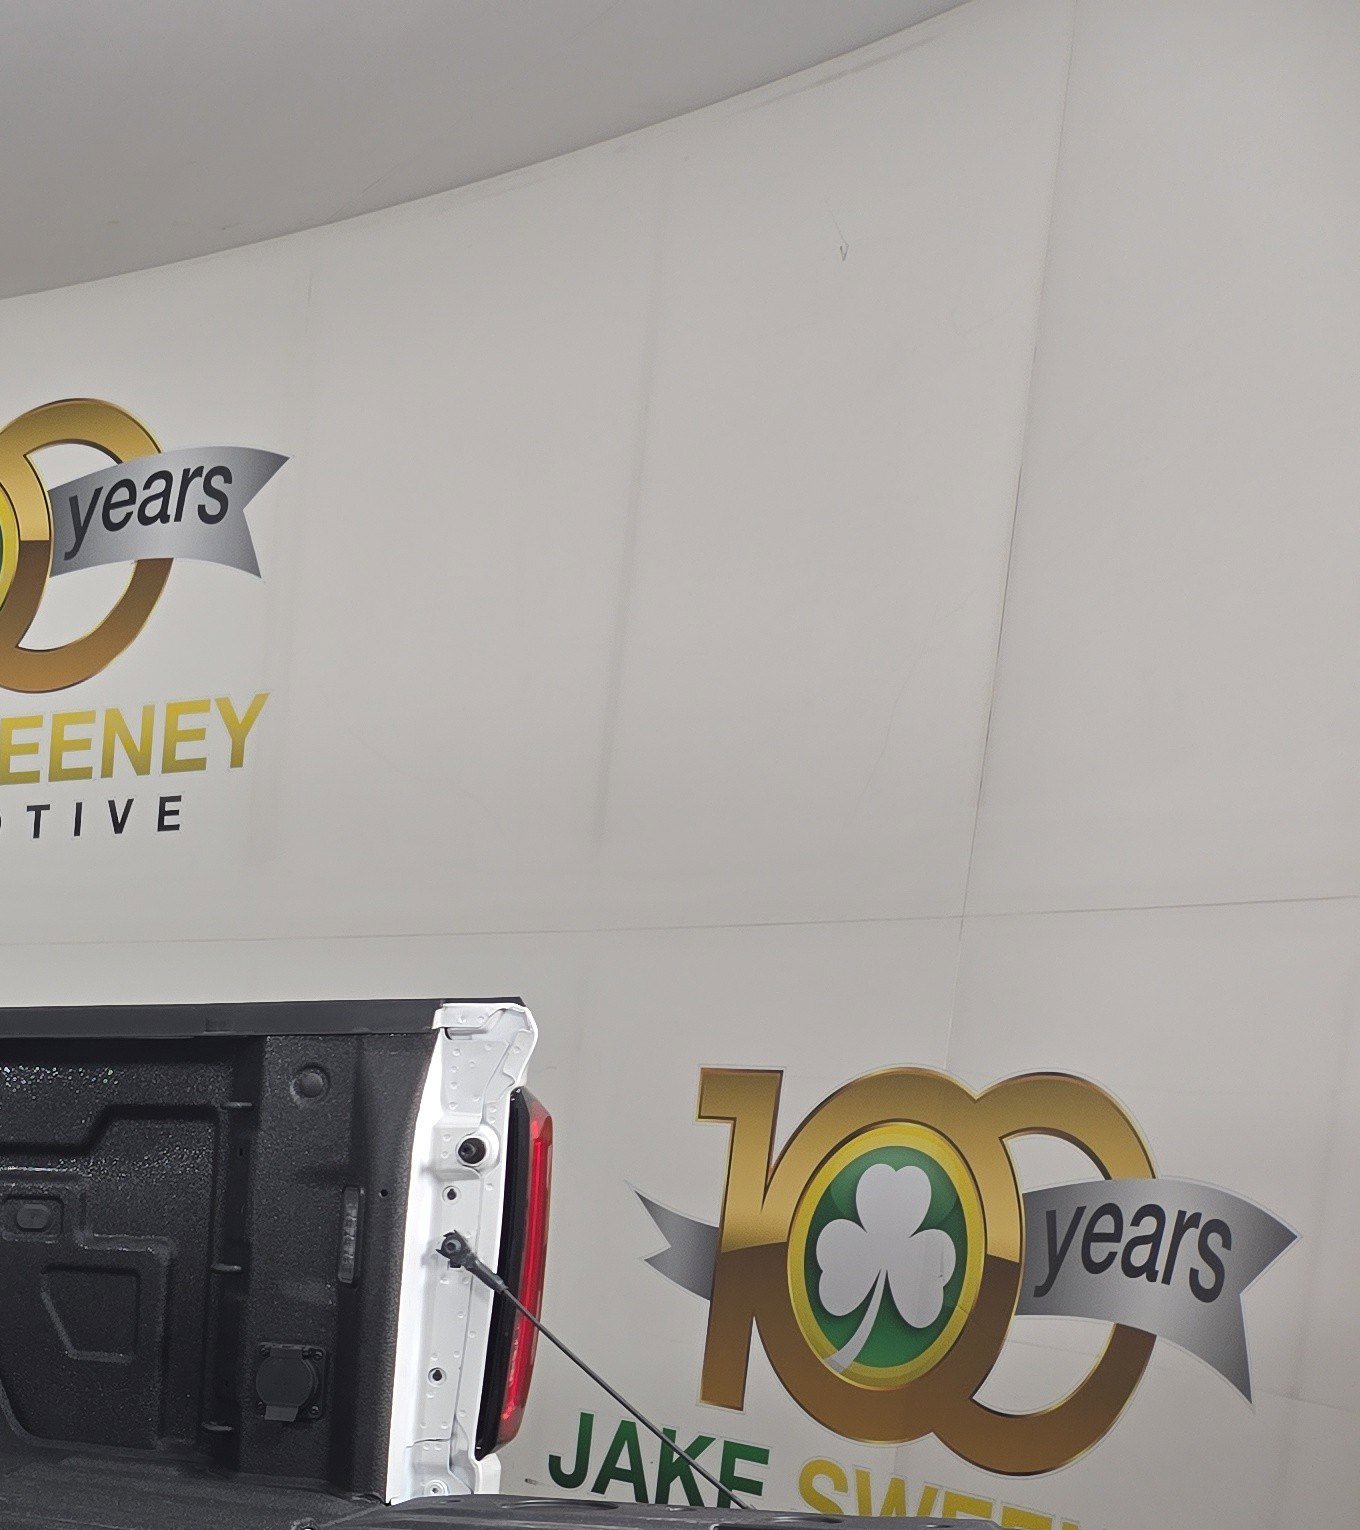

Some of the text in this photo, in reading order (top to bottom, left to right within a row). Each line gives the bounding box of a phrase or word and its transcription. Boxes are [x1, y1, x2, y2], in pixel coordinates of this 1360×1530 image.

[63, 464, 234, 562] years
[696, 1066, 1158, 1476] 100
[1033, 1202, 1235, 1304] years
